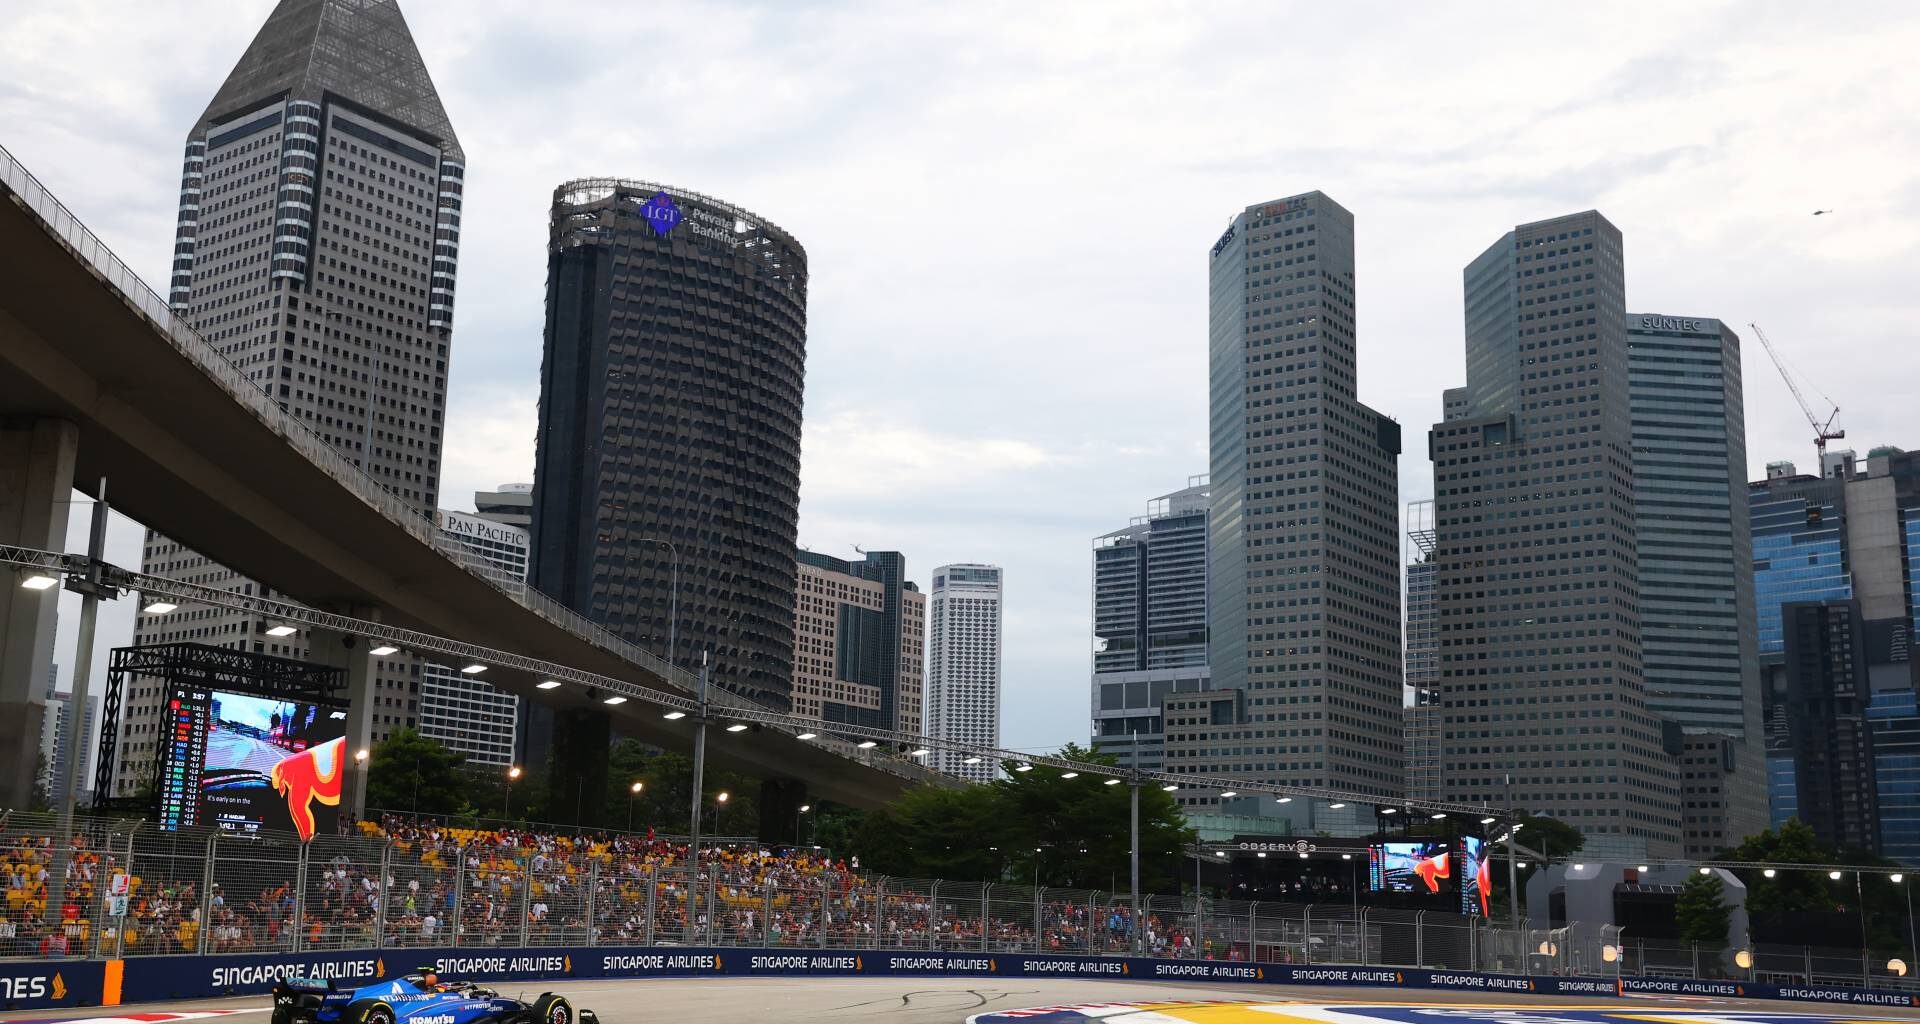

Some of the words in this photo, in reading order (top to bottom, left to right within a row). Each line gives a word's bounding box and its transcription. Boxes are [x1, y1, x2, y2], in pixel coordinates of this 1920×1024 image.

[647, 205, 678, 222] LGT
[693, 208, 733, 230] Private
[692, 223, 738, 248] Banking
[1642, 317, 1702, 331] SUNTEC
[448, 516, 473, 534] PAN
[477, 523, 524, 545] PACIFIC
[800, 566, 822, 576] NRAD
[436, 958, 506, 974] SINGAPORE
[510, 956, 562, 972] AIRLINES
[604, 956, 664, 970] SINGAPORE
[667, 956, 714, 968] AIRLINES
[752, 956, 808, 968] SINGAPORE
[811, 956, 855, 968] AIRLINES
[890, 958, 944, 970] SINGAPORE
[947, 958, 989, 970] AIRLINES
[1024, 960, 1076, 972] SINGAPORE
[1079, 962, 1122, 973] AIRLINES
[212, 964, 305, 986] SINGAPORE
[310, 961, 375, 981] AIRLINES
[1156, 964, 1208, 976] SINGAPORE
[1212, 967, 1256, 978] AIRLINES
[1291, 970, 1347, 980] SINGAPORE
[1350, 972, 1395, 982] AIRLINES
[1430, 974, 1483, 985] SINGAPORE
[1486, 976, 1528, 988] AIRLINES
[1558, 982, 1595, 992] SINGAPORE
[1622, 980, 1678, 991] INGAPORE
[1682, 984, 1735, 994] AIRLINES
[1780, 988, 1848, 1000] SINGAPORE
[1854, 994, 1910, 1004] AIRLINES
[409, 1014, 455, 1024] KOMATSU
